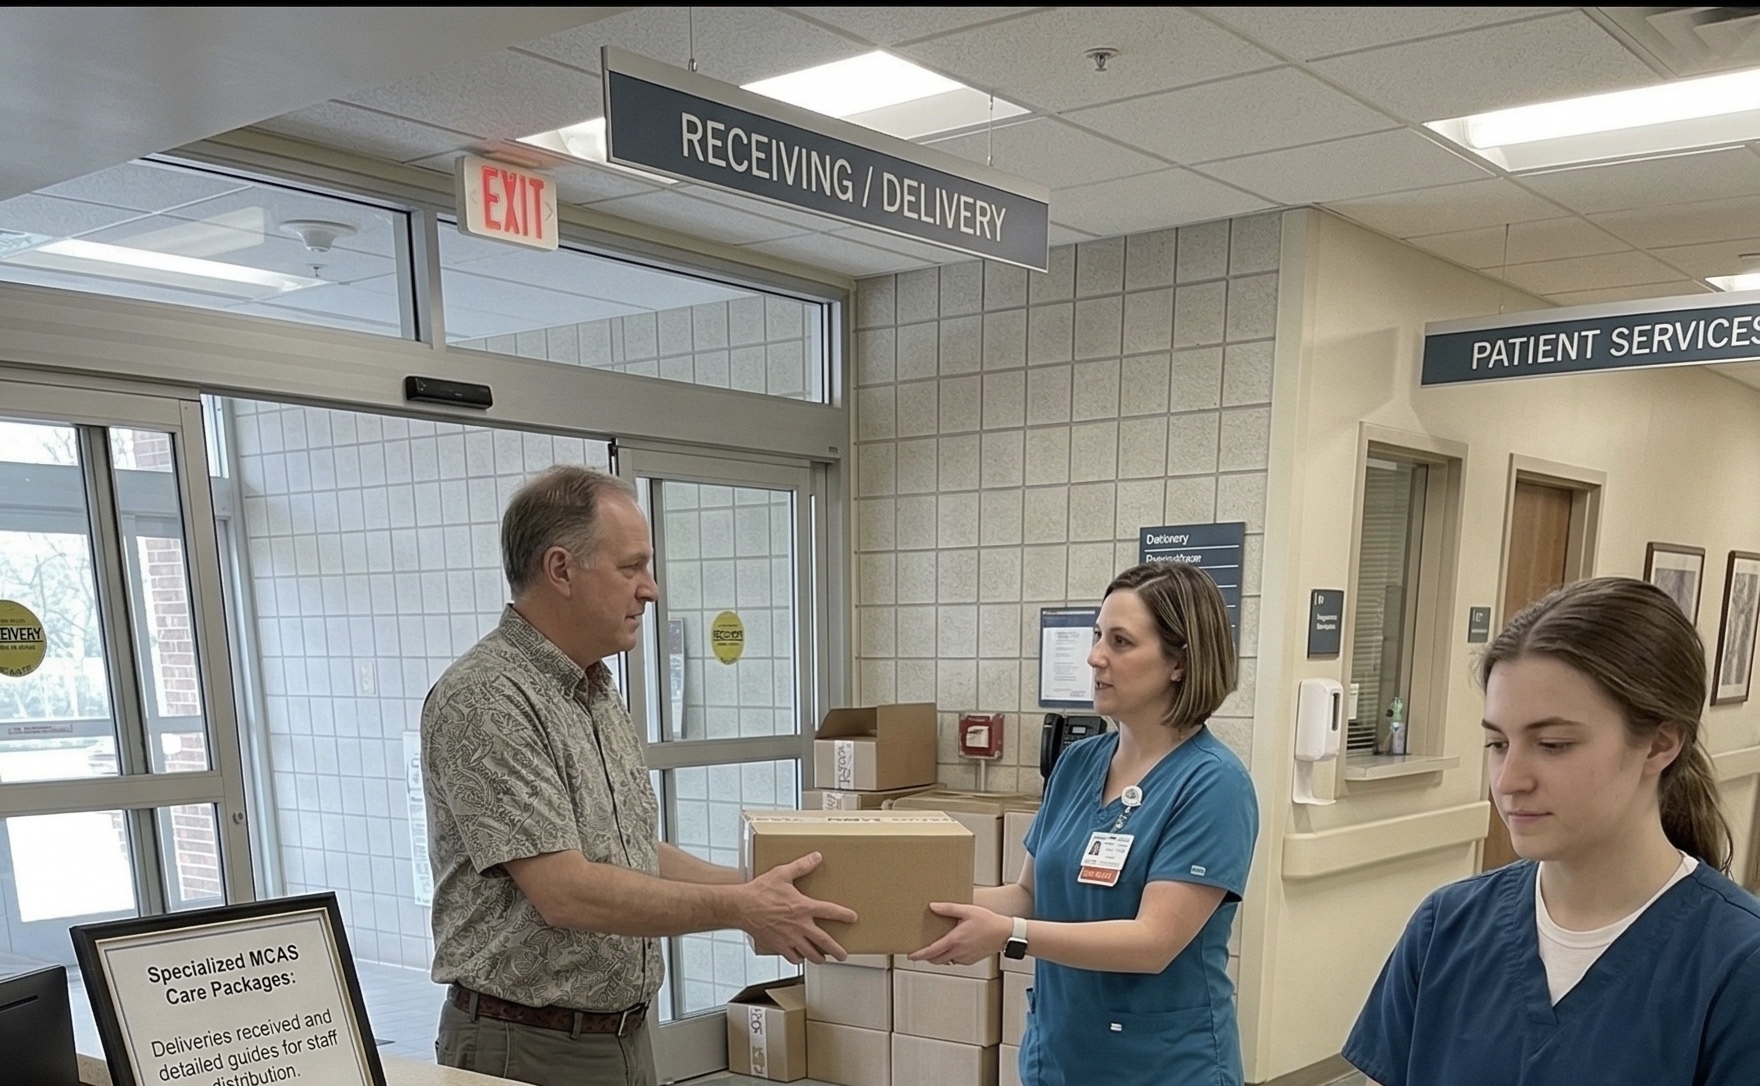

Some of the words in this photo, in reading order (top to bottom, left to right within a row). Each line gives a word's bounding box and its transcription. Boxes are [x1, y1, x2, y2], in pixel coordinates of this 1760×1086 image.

[681, 112, 853, 203] RECEIVING
[862, 167, 874, 208] /
[883, 172, 1008, 243] DELIVERY
[480, 166, 545, 240] EXIT
[1471, 329, 1601, 370] PATIENT
[147, 952, 246, 985] Specialized
[249, 944, 299, 967] MCAS
[166, 987, 207, 1005] Care
[210, 971, 296, 997] Packages:
[151, 1030, 232, 1058] Deliveries
[236, 1014, 301, 1041] received
[304, 1008, 333, 1028] and
[159, 1053, 224, 1082] detailed
[228, 1045, 279, 1071] guides
[282, 1039, 302, 1056] for
[307, 1030, 339, 1050] staff
